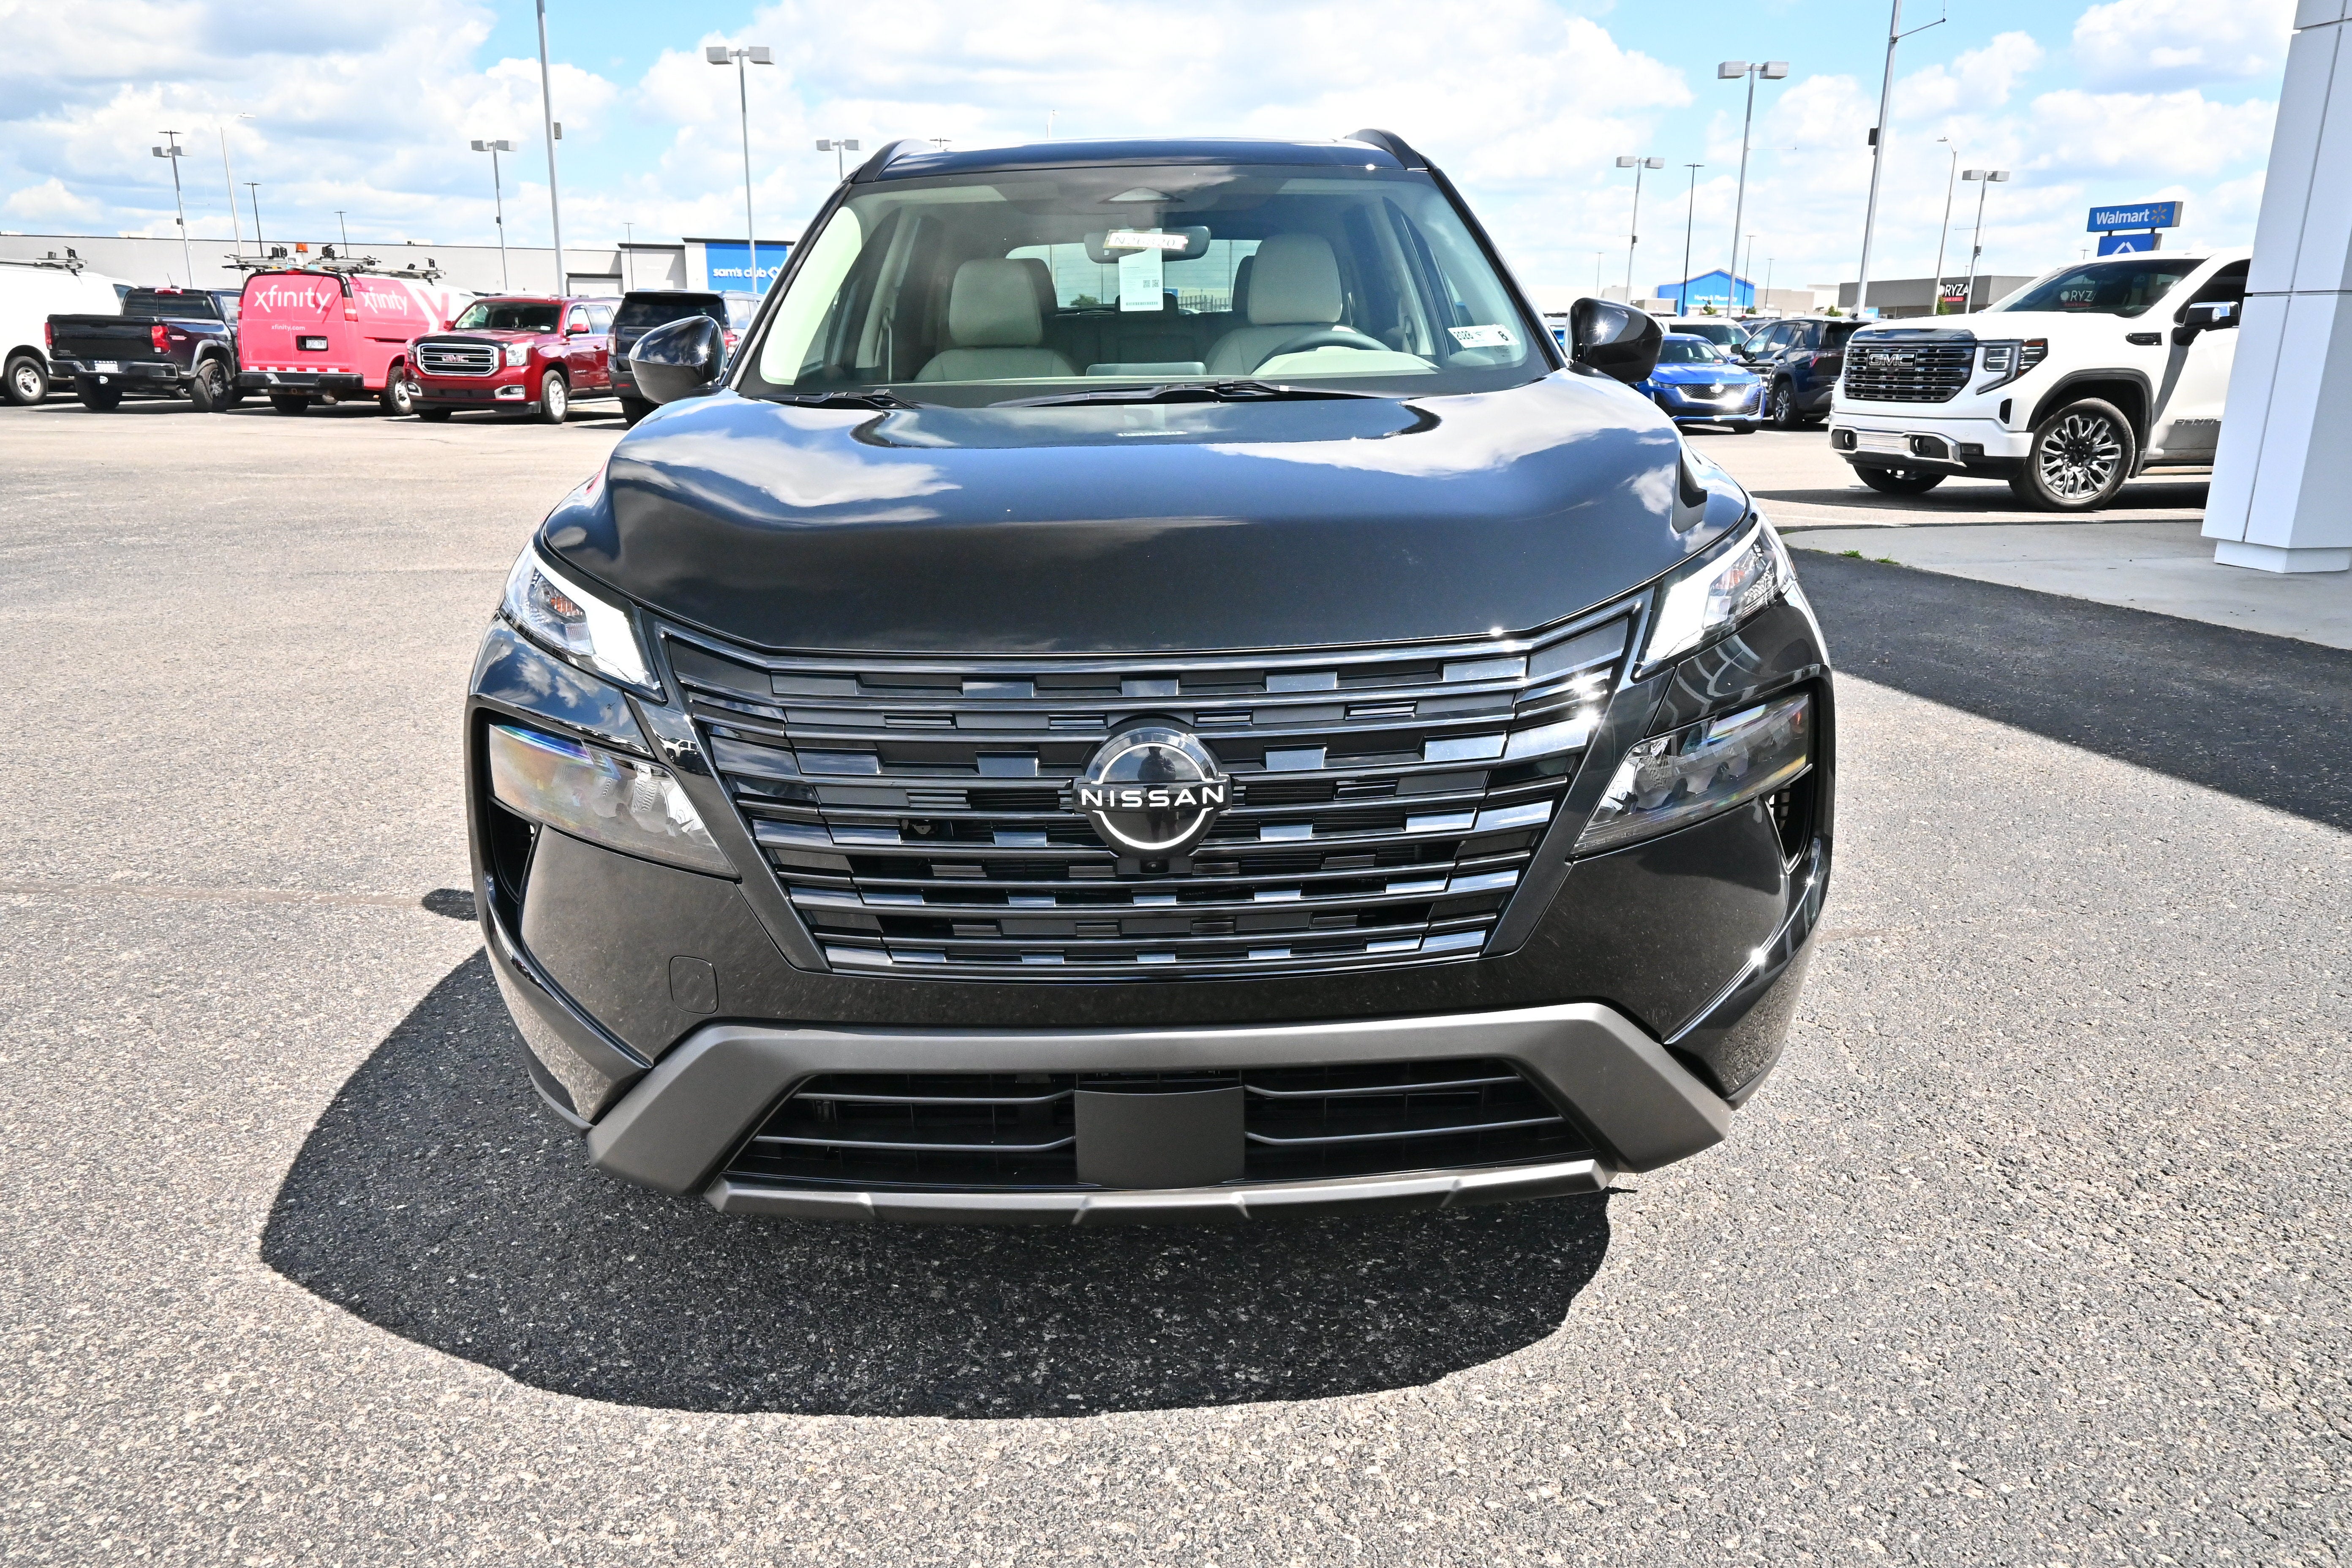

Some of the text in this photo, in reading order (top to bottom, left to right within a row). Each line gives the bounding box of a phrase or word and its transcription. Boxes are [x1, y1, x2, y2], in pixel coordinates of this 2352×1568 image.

[2096, 209, 2150, 225] Walmart
[713, 267, 742, 277] sam's
[1945, 283, 1968, 296] RYZA
[254, 285, 331, 314] xfinity
[360, 286, 407, 316] xfinity
[1454, 331, 1473, 340] 2028
[1498, 331, 1509, 341] 8
[1869, 354, 1914, 366] GMC
[1081, 785, 1223, 807] NISSAN
